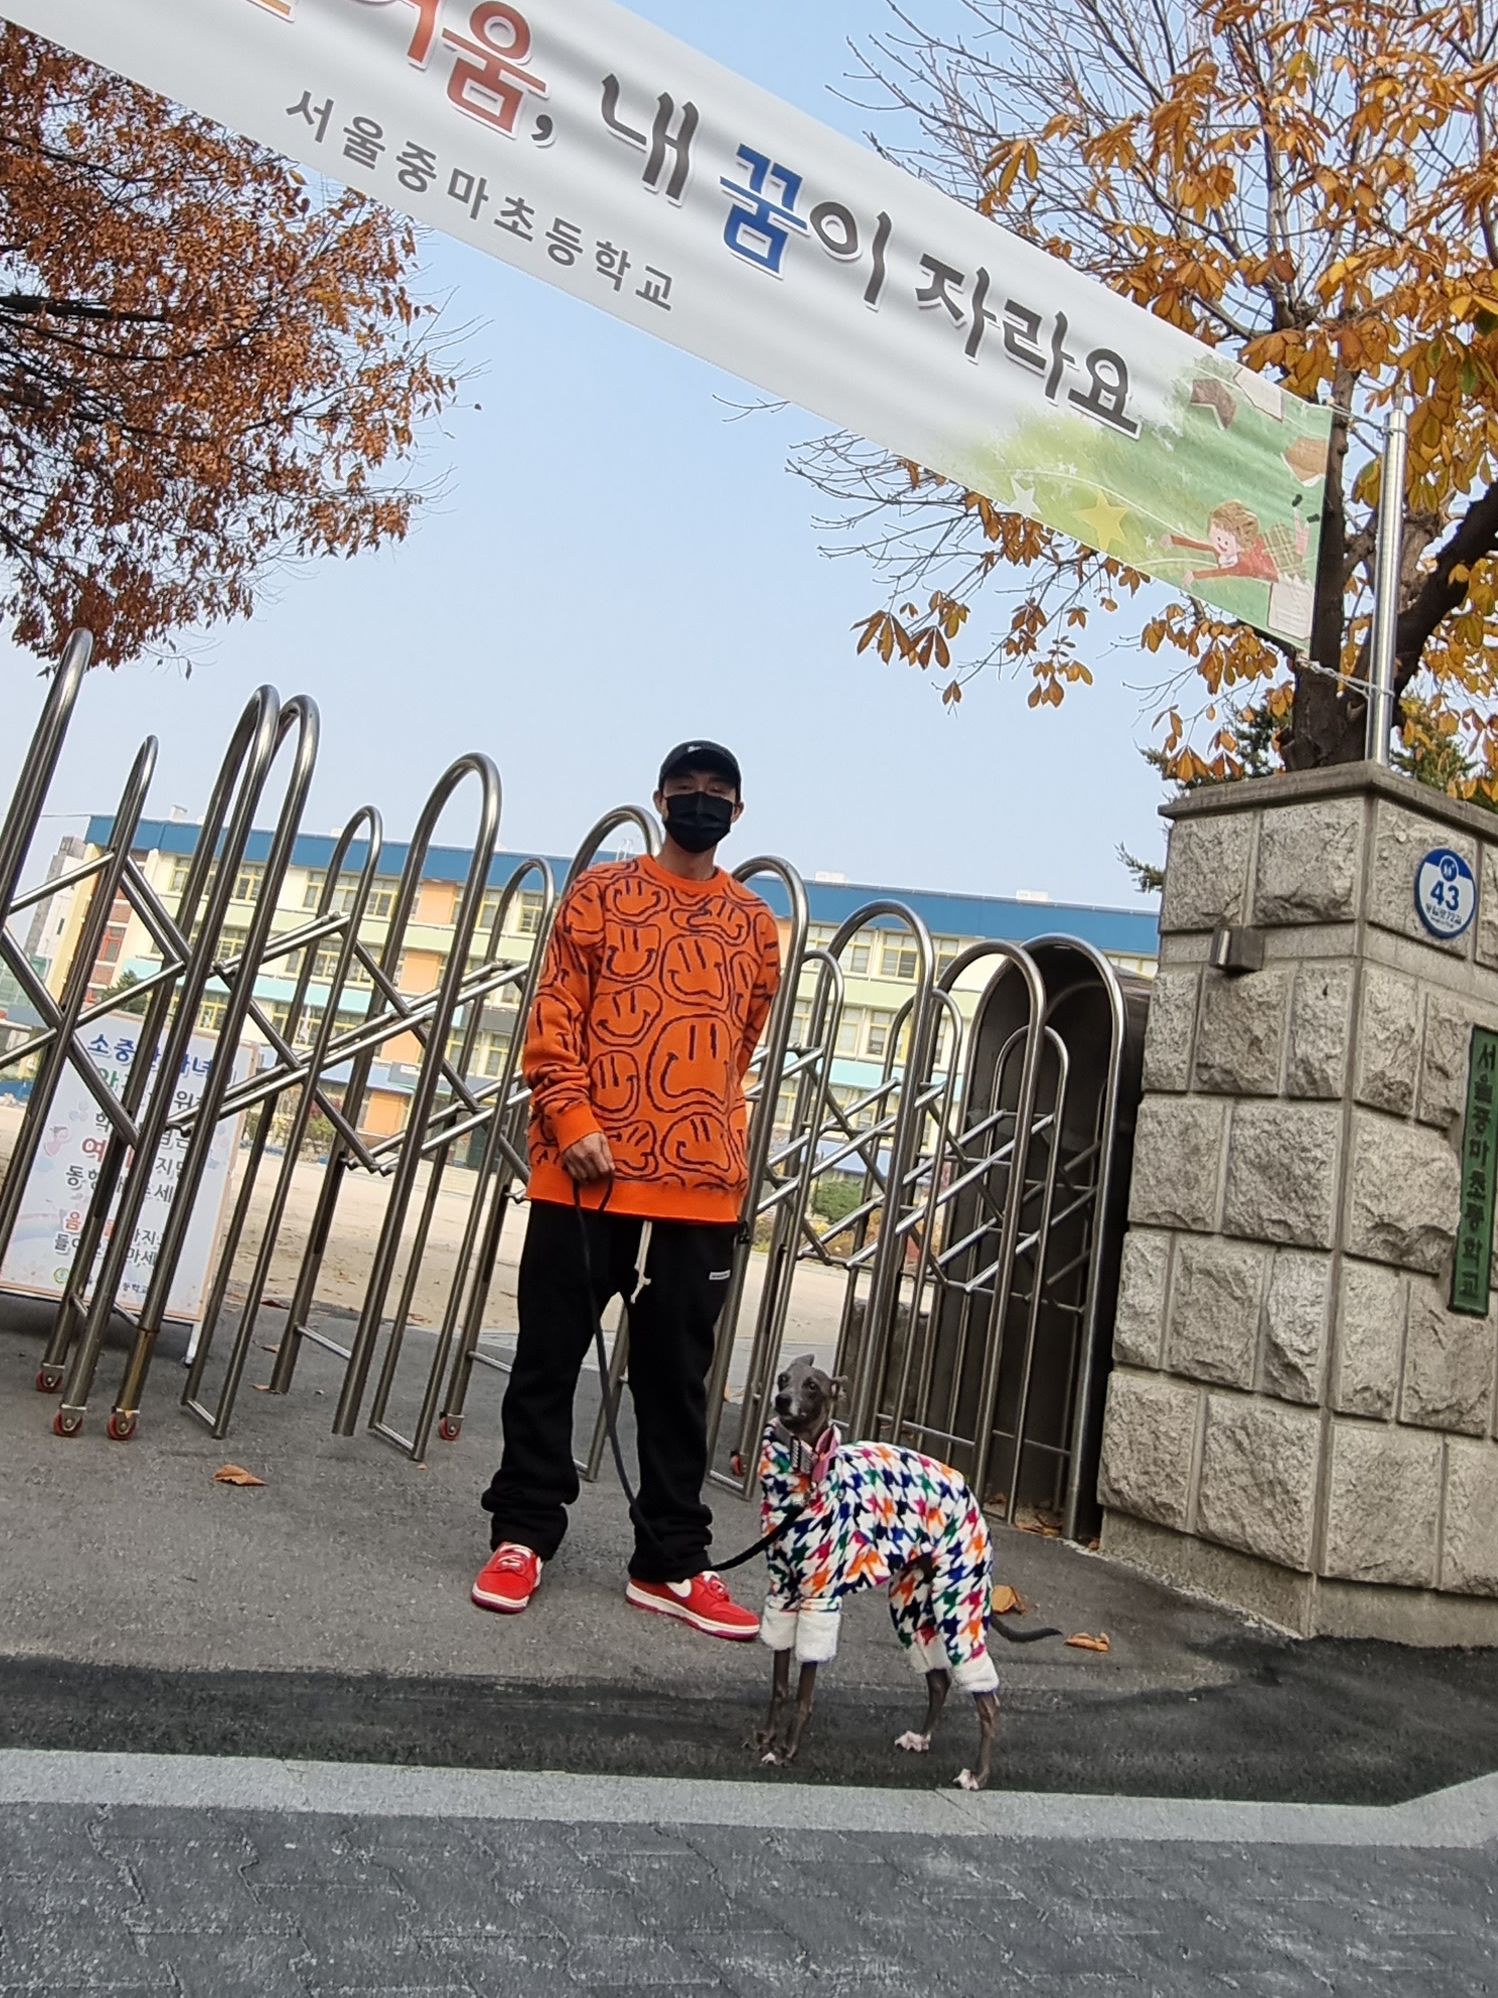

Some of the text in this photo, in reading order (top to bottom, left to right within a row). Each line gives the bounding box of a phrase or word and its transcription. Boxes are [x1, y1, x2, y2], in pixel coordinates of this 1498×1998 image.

[286, 90, 671, 310] 서울중마초등학교
[602, 73, 699, 200] 내
[720, 142, 891, 303] 꿈이
[916, 252, 1138, 434] 자라요
[1430, 880, 1460, 911] 43
[1459, 1042, 1496, 1298] 서울중마초등학교
